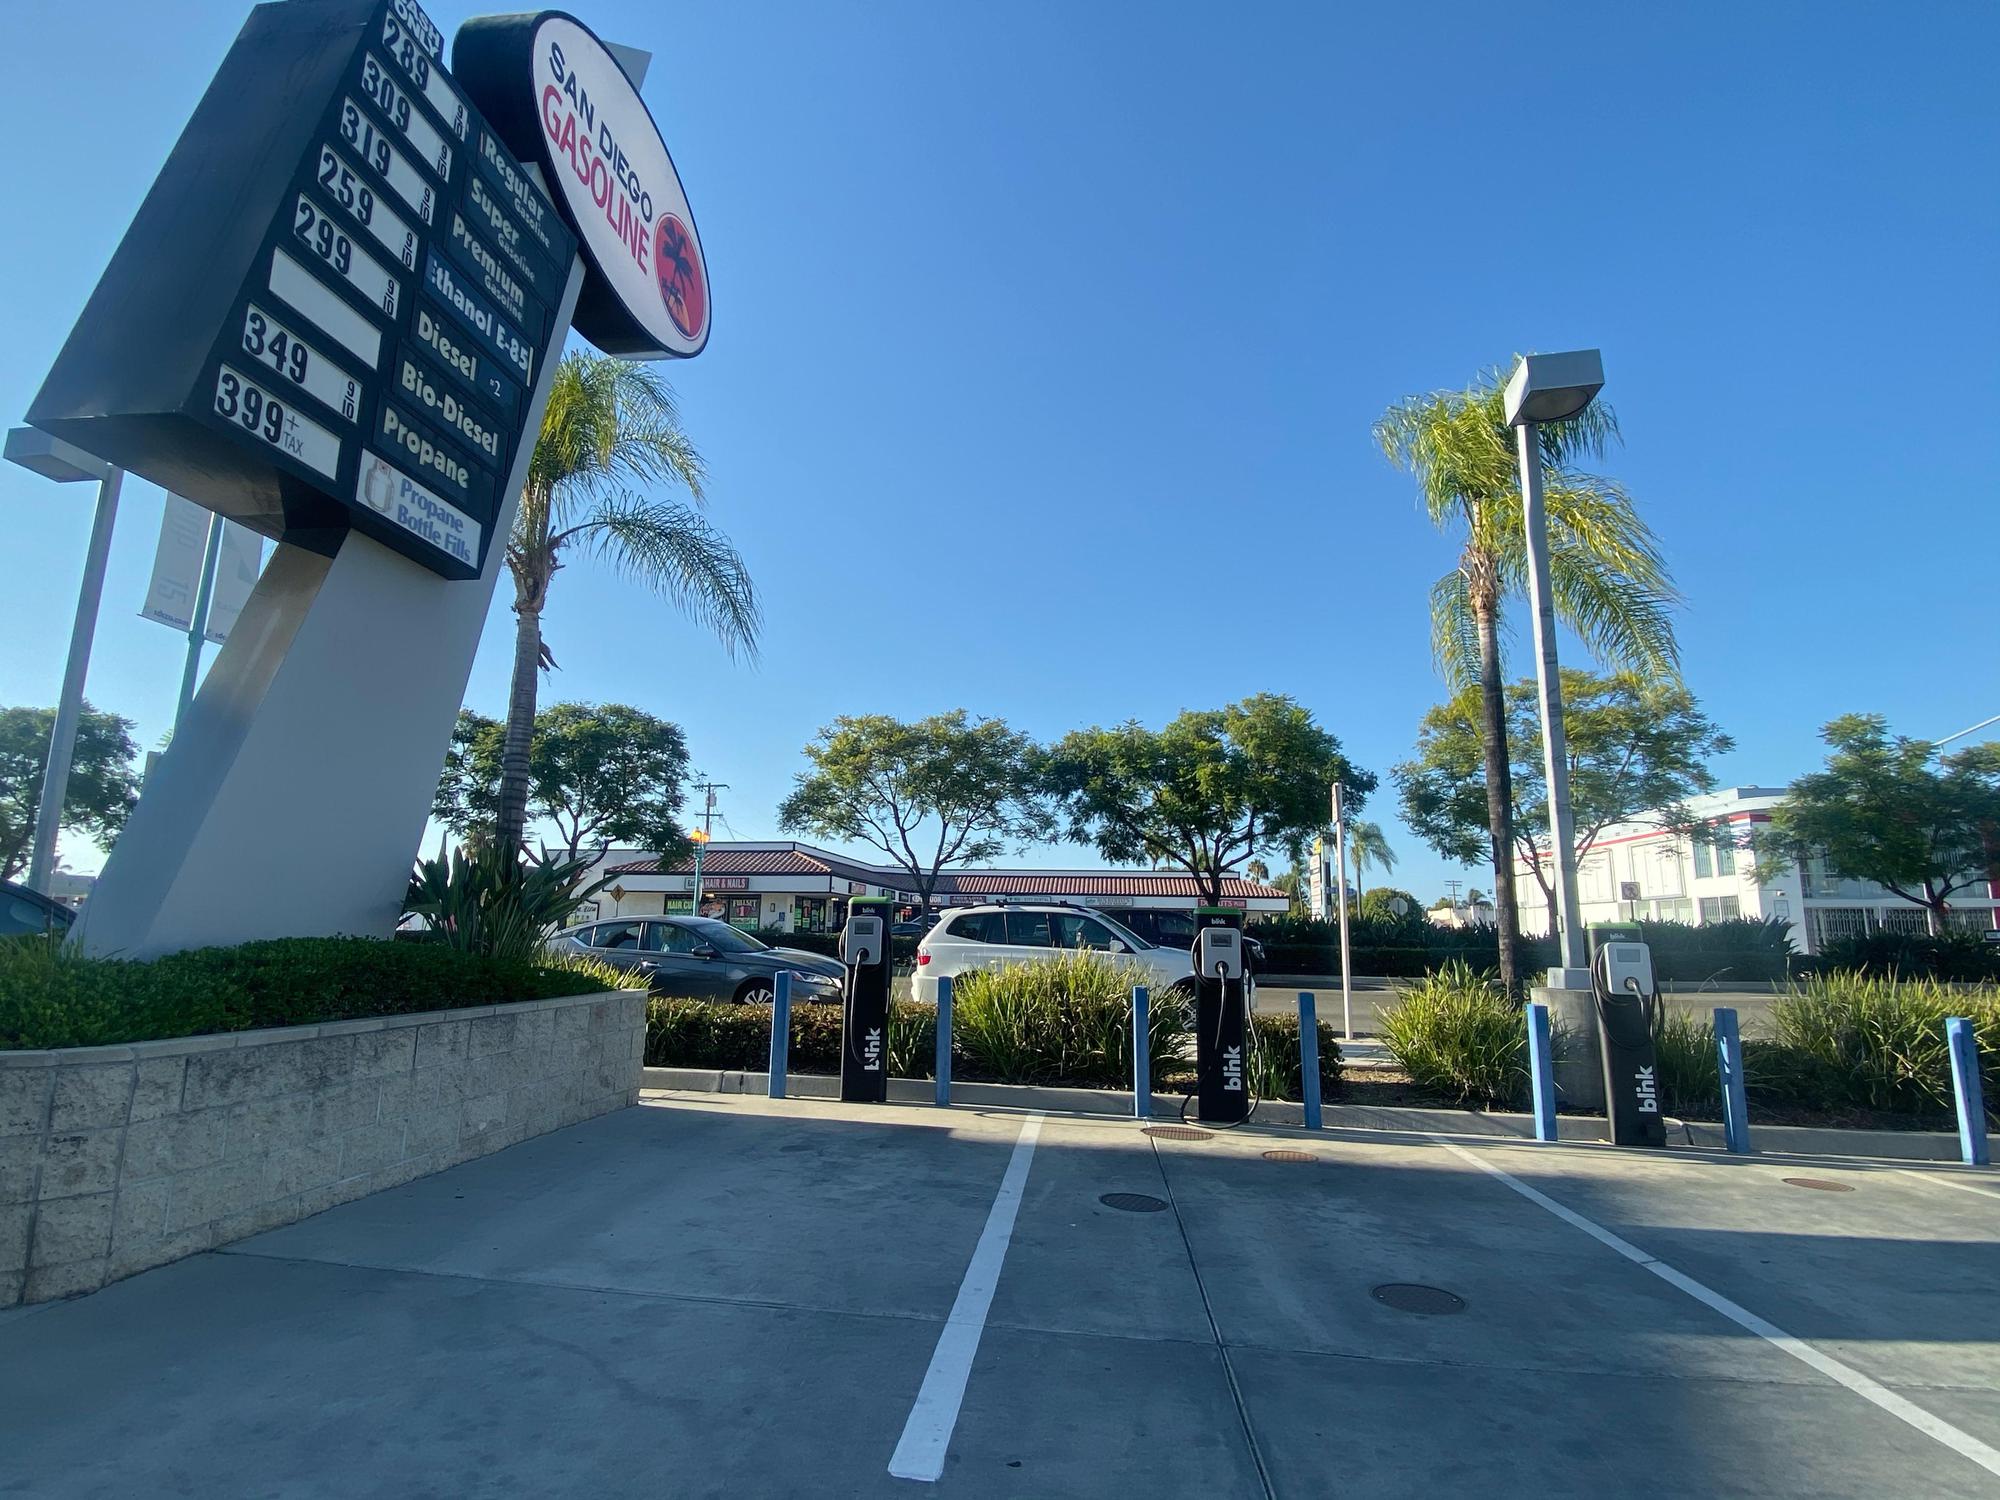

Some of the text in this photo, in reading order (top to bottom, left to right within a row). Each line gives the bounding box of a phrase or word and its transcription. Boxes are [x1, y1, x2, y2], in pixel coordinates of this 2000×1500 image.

[383, 18, 429, 91] 289
[394, 0, 440, 58] ONLY
[400, 0, 440, 48] ASH
[363, 60, 410, 134] 309
[549, 42, 652, 223] SAN DIEGO
[342, 104, 391, 177] 319
[318, 150, 374, 226] 259
[471, 179, 519, 245] Super
[485, 135, 544, 220] Regular
[543, 84, 649, 275] GASOLINE
[295, 202, 351, 275] 299
[498, 233, 535, 282] Gasoline
[514, 198, 550, 248] Gasoline
[453, 213, 524, 308] Premium
[432, 260, 528, 370] thanol E-85
[484, 275, 522, 321] Gasoline
[245, 311, 308, 384] 349
[418, 310, 477, 381] Diesel
[217, 373, 284, 444] 399
[402, 361, 498, 456] Bio-Diesel
[285, 432, 304, 457] TAX
[383, 406, 470, 488] Propane
[398, 504, 471, 562] Bottle Fills
[401, 478, 464, 533] Propane
[705, 879, 720, 888] HAIR
[727, 879, 746, 888] NAILS
[864, 1027, 880, 1070] blink
[1224, 1044, 1241, 1091] blink
[1634, 1064, 1658, 1113] blink
